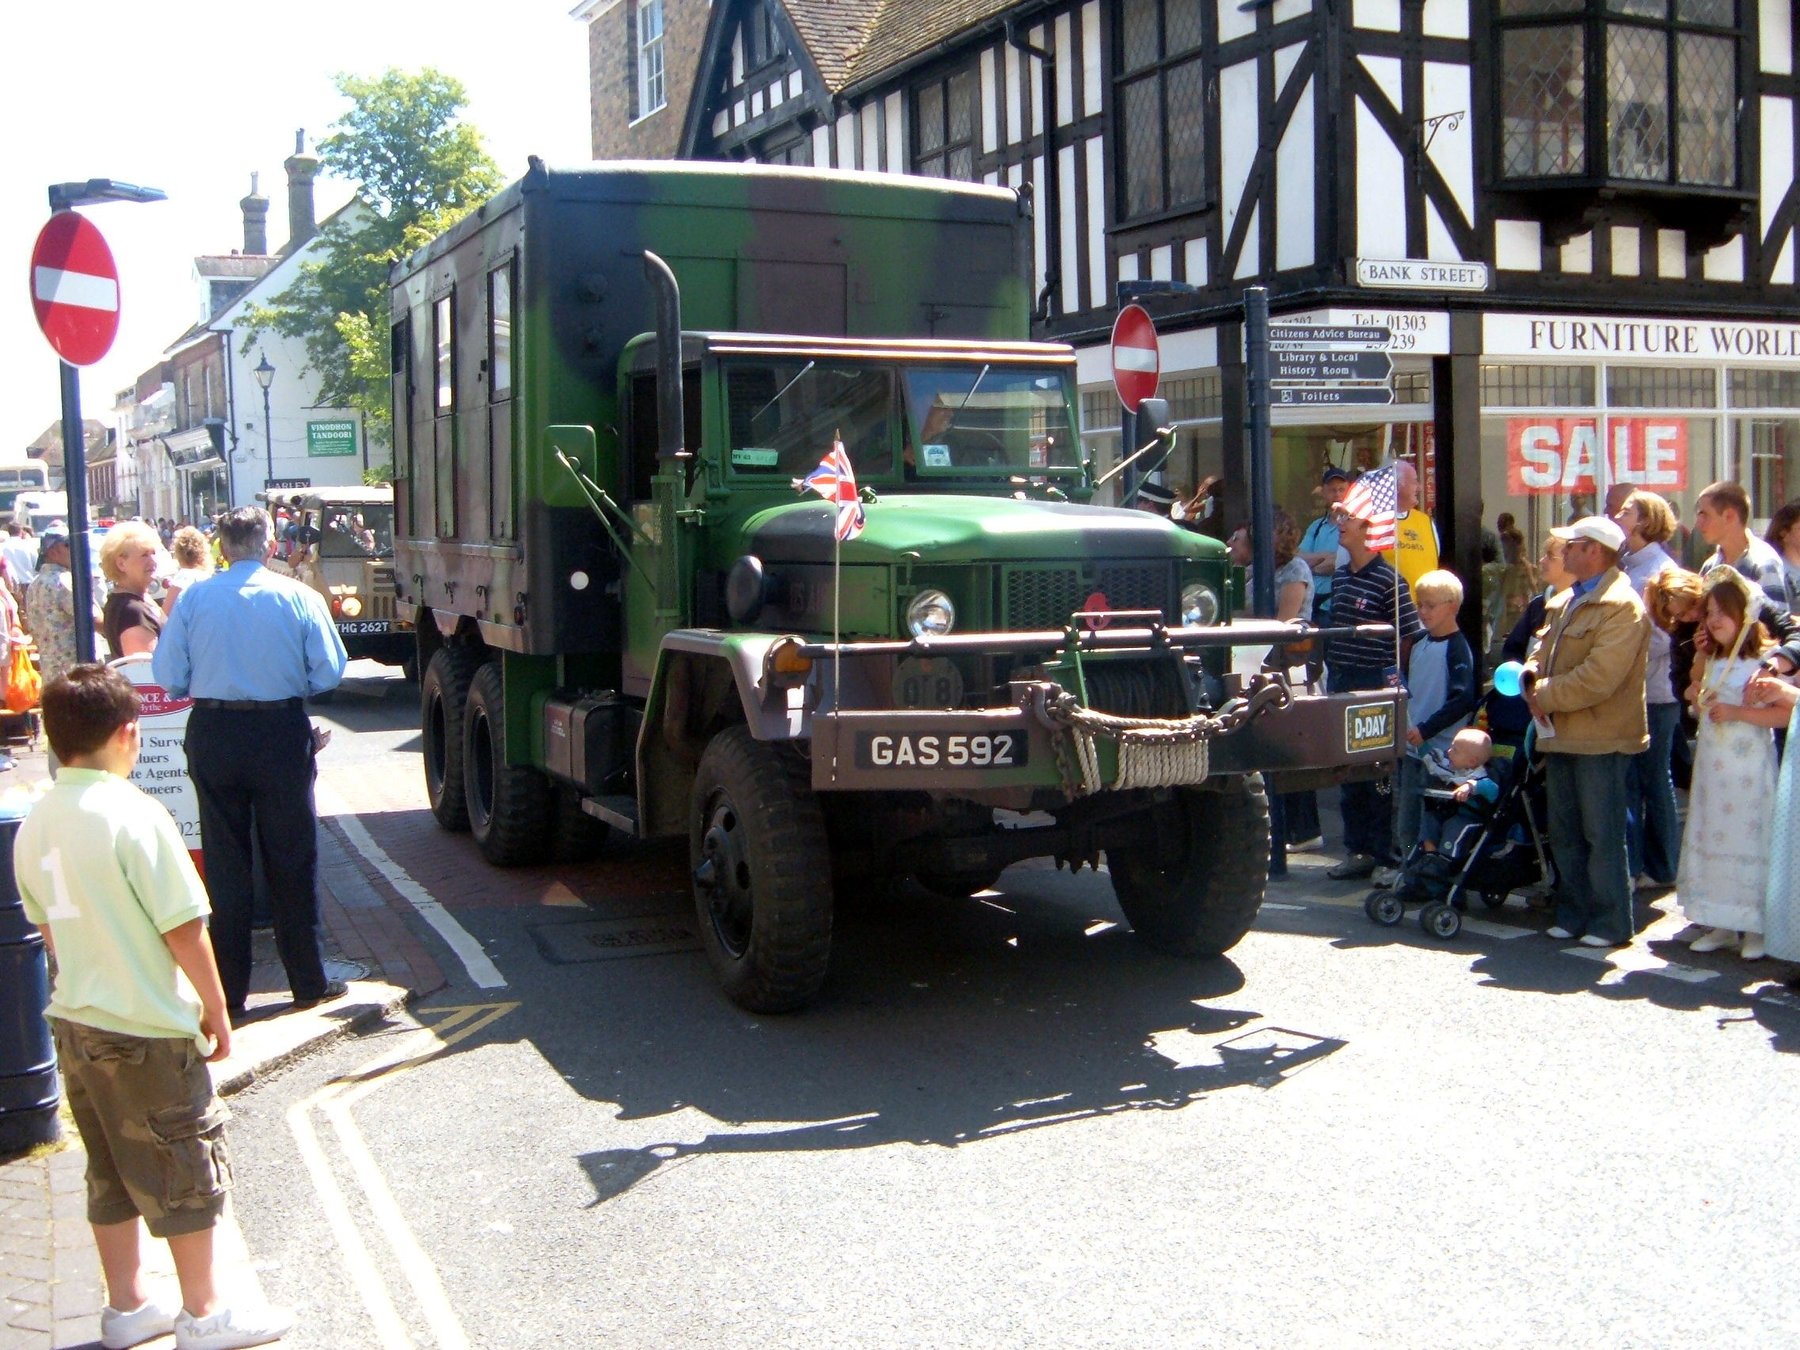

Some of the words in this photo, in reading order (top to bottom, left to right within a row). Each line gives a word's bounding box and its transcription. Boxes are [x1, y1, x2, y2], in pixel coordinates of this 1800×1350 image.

[1369, 265, 1412, 280] BANK
[1420, 267, 1477, 283] STREET
[1386, 315, 1427, 331] 01303
[1270, 329, 1310, 339] Citizens
[1312, 329, 1344, 339] Advice
[1347, 329, 1380, 339] Bureau
[1529, 320, 1699, 353] FURNITURE
[1279, 352, 1315, 364] Library
[1319, 353, 1328, 361] &
[1331, 352, 1358, 362] Local
[1280, 366, 1316, 376] History
[1322, 366, 1349, 375] Room
[1301, 391, 1340, 400] Toilets
[311, 431, 352, 439] TANDOORI
[1520, 425, 1678, 488] SALE
[360, 621, 389, 633] 262T
[138, 692, 160, 703] NCE
[1355, 714, 1386, 739] D-DAY
[149, 736, 185, 748] Surve
[871, 736, 940, 765] GAS
[947, 735, 1013, 765] 592
[138, 753, 169, 764] luers
[146, 768, 189, 781] Agents
[139, 784, 183, 795] ioneers
[41, 847, 82, 919] 1
